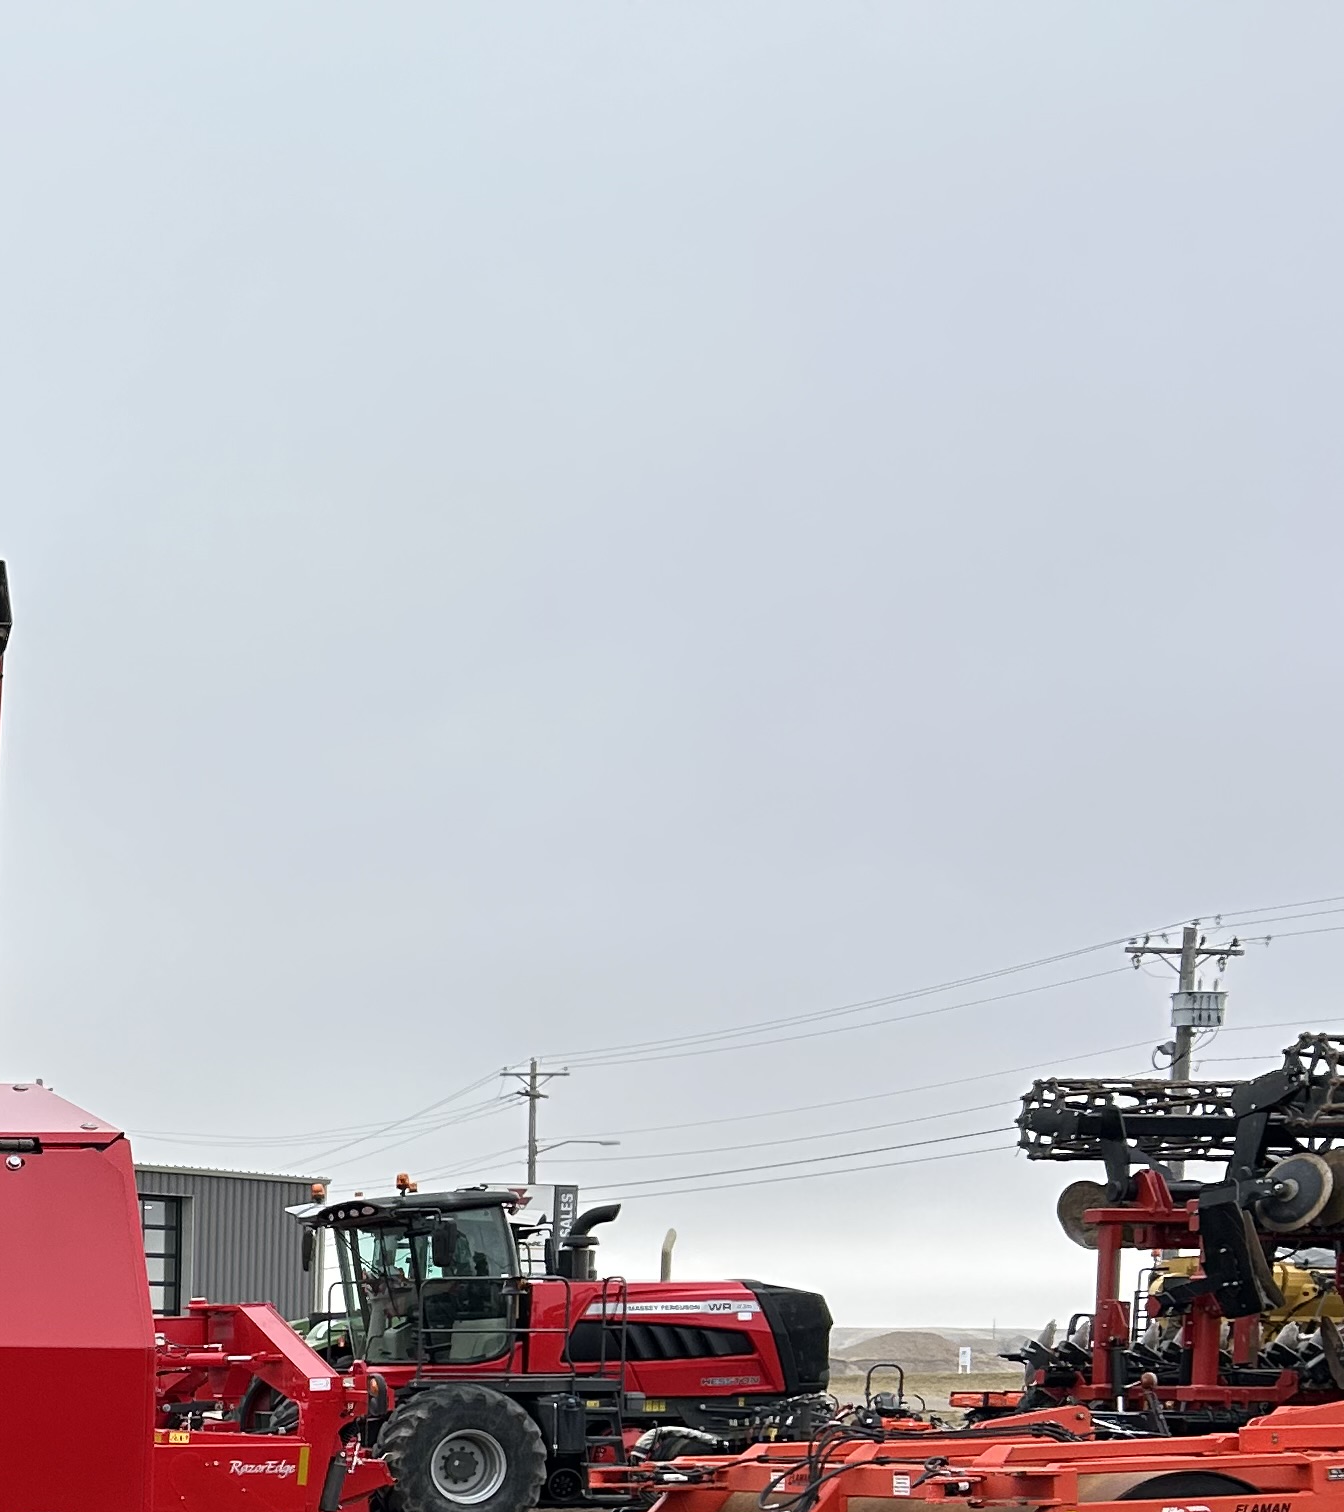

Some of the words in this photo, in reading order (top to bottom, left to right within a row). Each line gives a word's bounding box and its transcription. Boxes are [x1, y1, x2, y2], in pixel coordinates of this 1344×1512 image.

[559, 1193, 574, 1239] SALES
[708, 1302, 732, 1311] WR
[229, 1459, 296, 1479] RazorEdge
